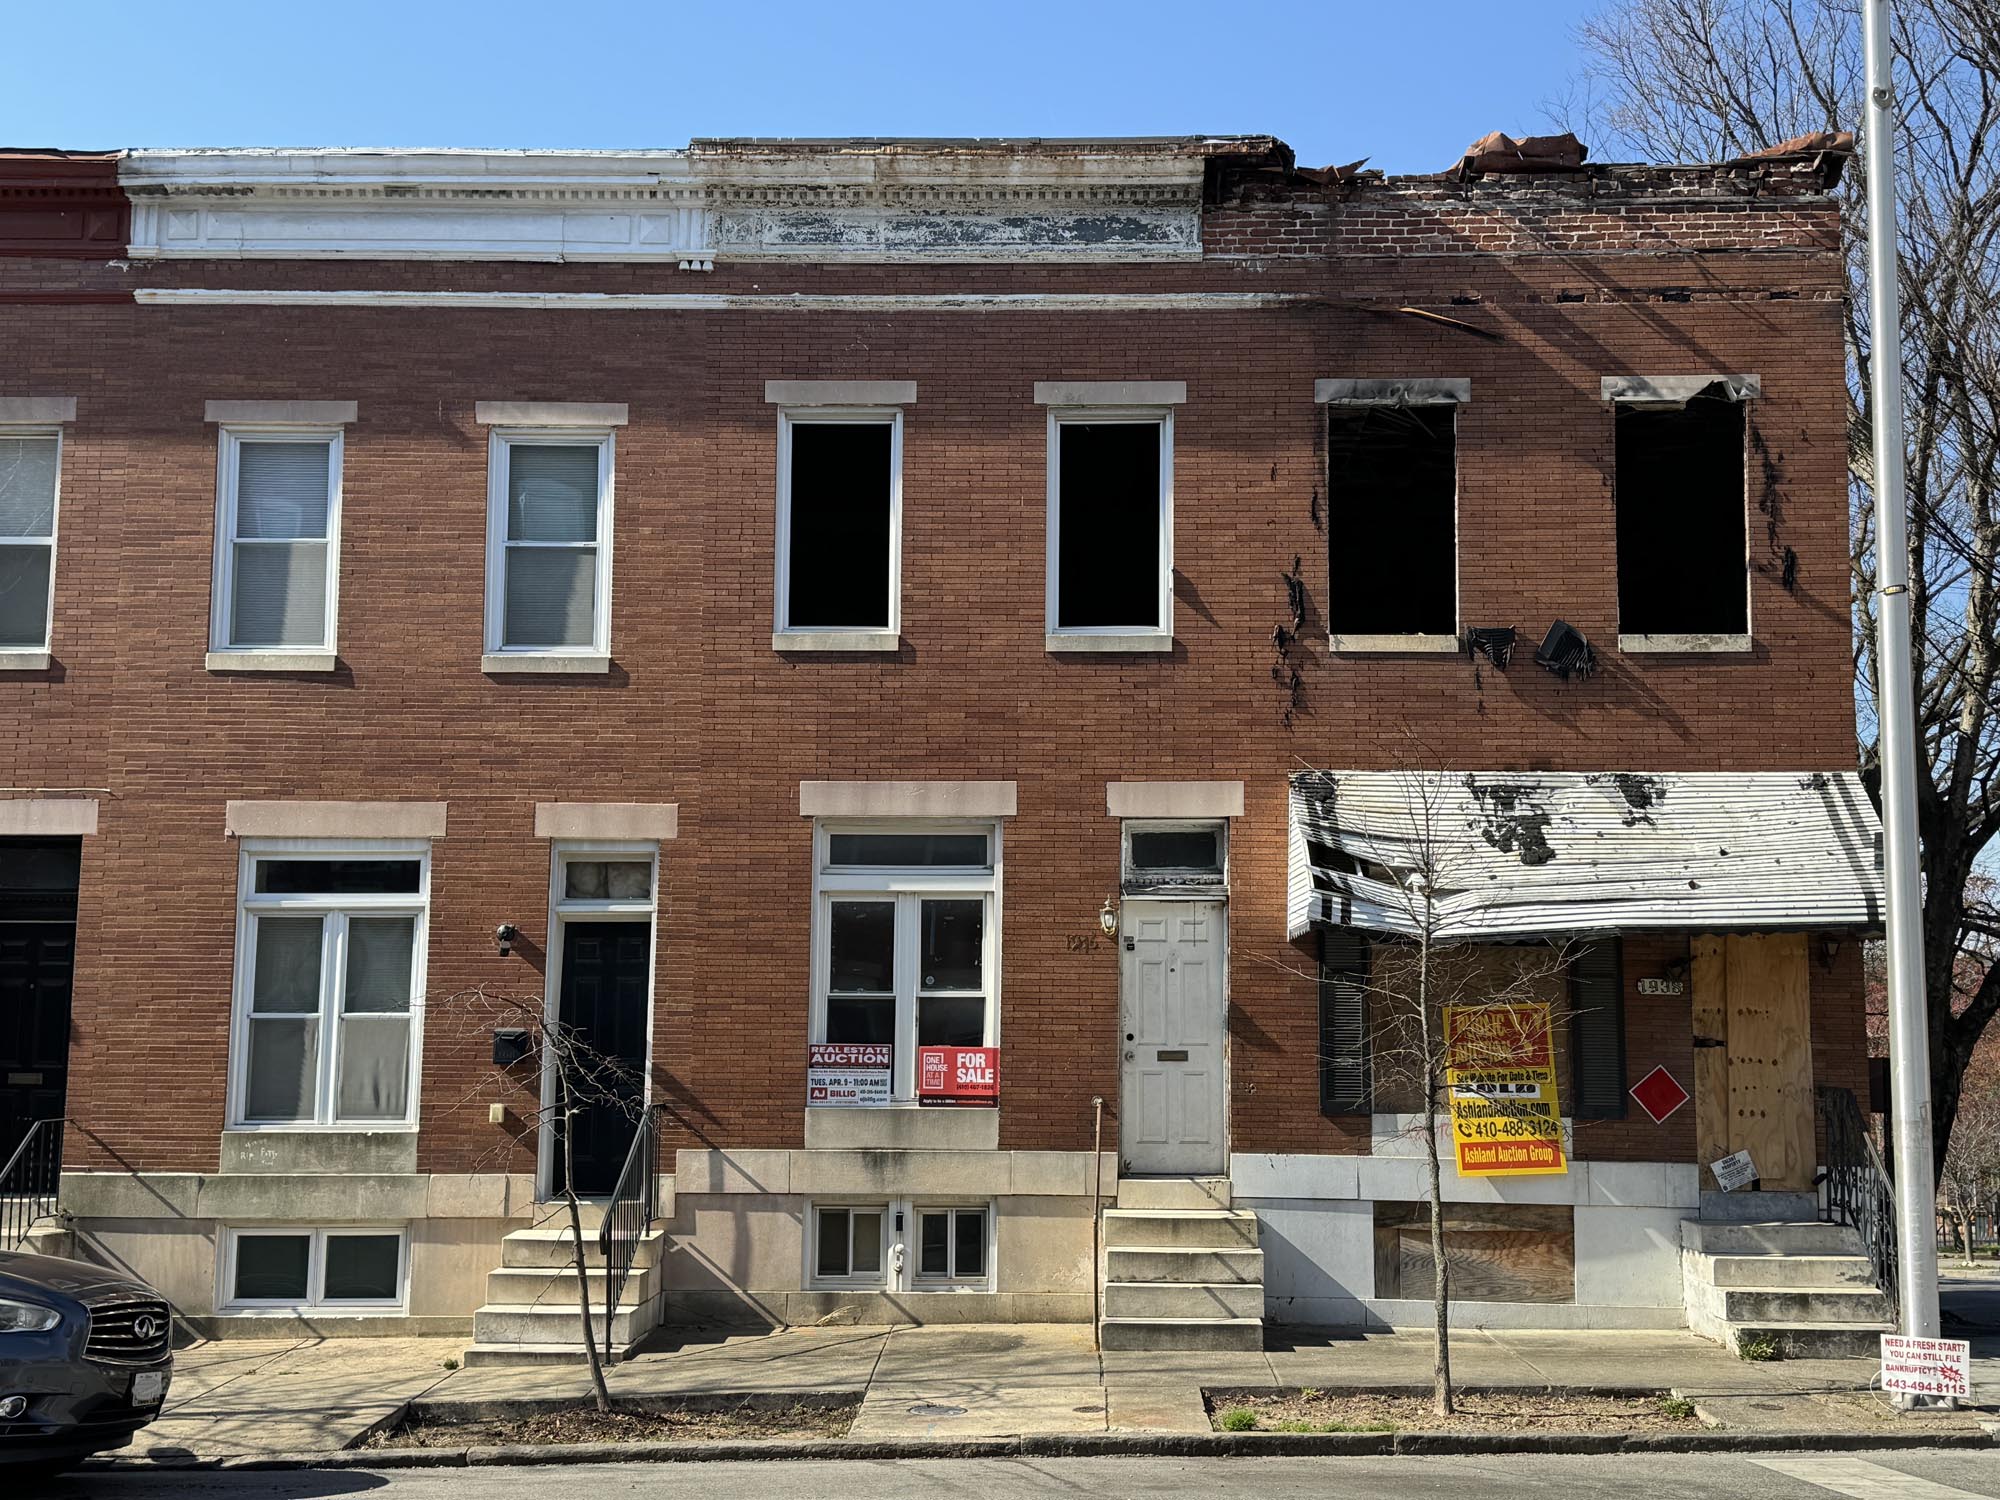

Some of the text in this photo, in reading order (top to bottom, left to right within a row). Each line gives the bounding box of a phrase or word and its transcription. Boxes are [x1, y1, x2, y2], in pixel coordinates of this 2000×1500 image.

[1641, 980, 1681, 993] 1938
[811, 1053, 889, 1064] AUCTION
[926, 1056, 940, 1064] ONE
[956, 1053, 986, 1068] FOR
[926, 1064, 948, 1072] HOUSE
[956, 1068, 994, 1083] SALE
[1456, 1073, 1468, 1083] See
[1497, 1071, 1508, 1081] For
[1509, 1070, 1525, 1080] Date
[1525, 1070, 1532, 1080] &
[811, 1079, 828, 1087] TUES.
[829, 1079, 844, 1087] APR.
[869, 1079, 880, 1087] AM
[813, 1090, 857, 1098] AJ BILLIG
[1475, 1120, 1558, 1138] 410-488-3124
[1465, 1145, 1553, 1163] Ashland Auction Group
[1885, 1338, 1966, 1353] NEED A FRESH START?
[1890, 1350, 1961, 1363] YOU CAN STILL FILE
[1885, 1378, 1967, 1395] 443-494-8115
